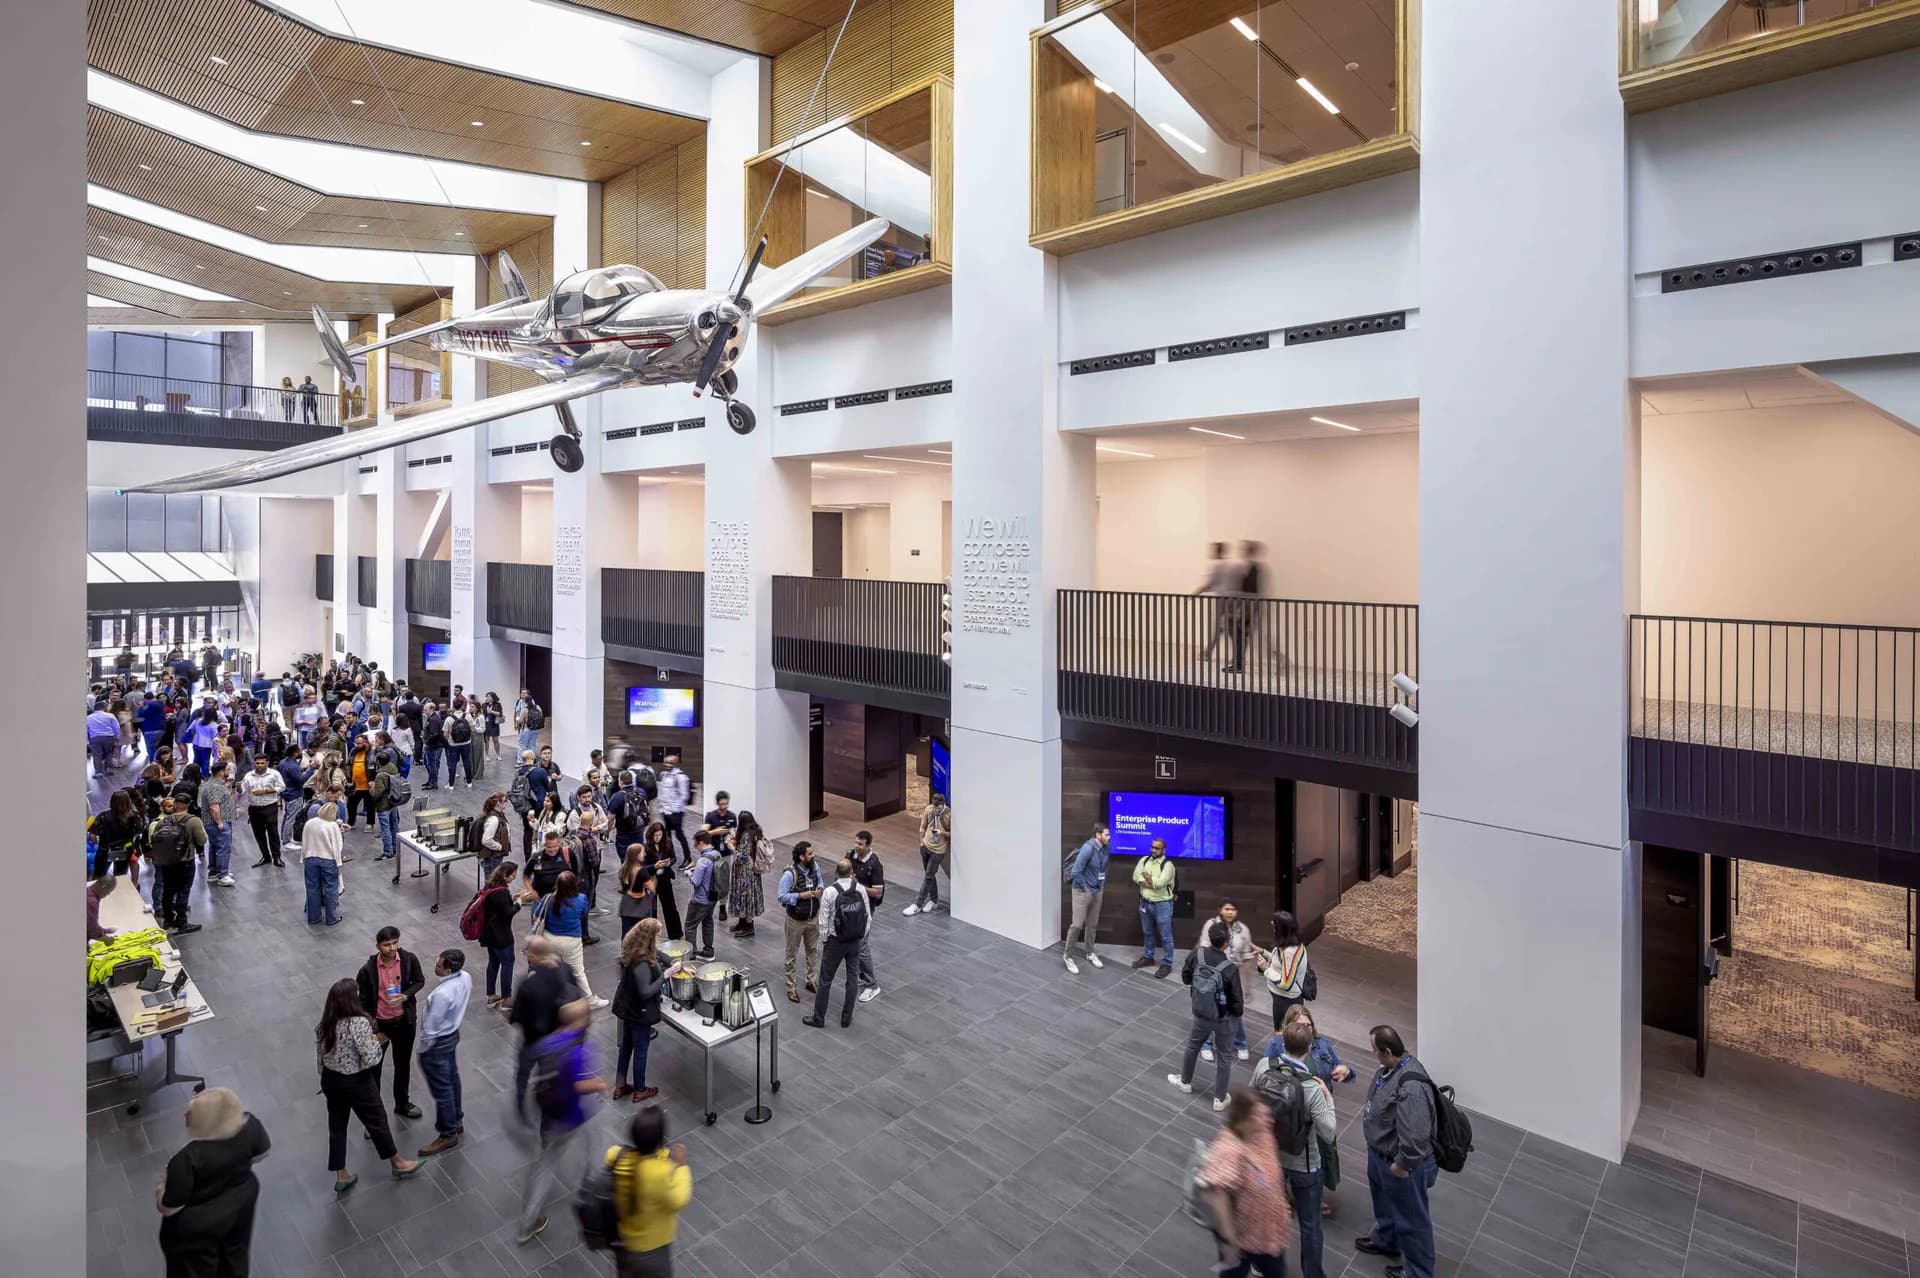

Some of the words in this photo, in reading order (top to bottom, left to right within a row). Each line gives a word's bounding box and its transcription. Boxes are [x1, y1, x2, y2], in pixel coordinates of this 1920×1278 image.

[962, 514, 995, 538] We
[996, 513, 1029, 538] will
[963, 542, 1030, 560] compete
[963, 557, 988, 573] and
[990, 560, 1008, 574] we
[1009, 558, 1030, 574] will
[963, 572, 1016, 590] continue
[1017, 574, 1030, 590] to
[994, 590, 1007, 604] to
[1008, 591, 1030, 605] our
[660, 671, 667, 680] A
[1161, 763, 1170, 776] L
[1115, 814, 1157, 823] Enterprise
[1157, 816, 1189, 825] Product
[1115, 821, 1146, 830] Summit
